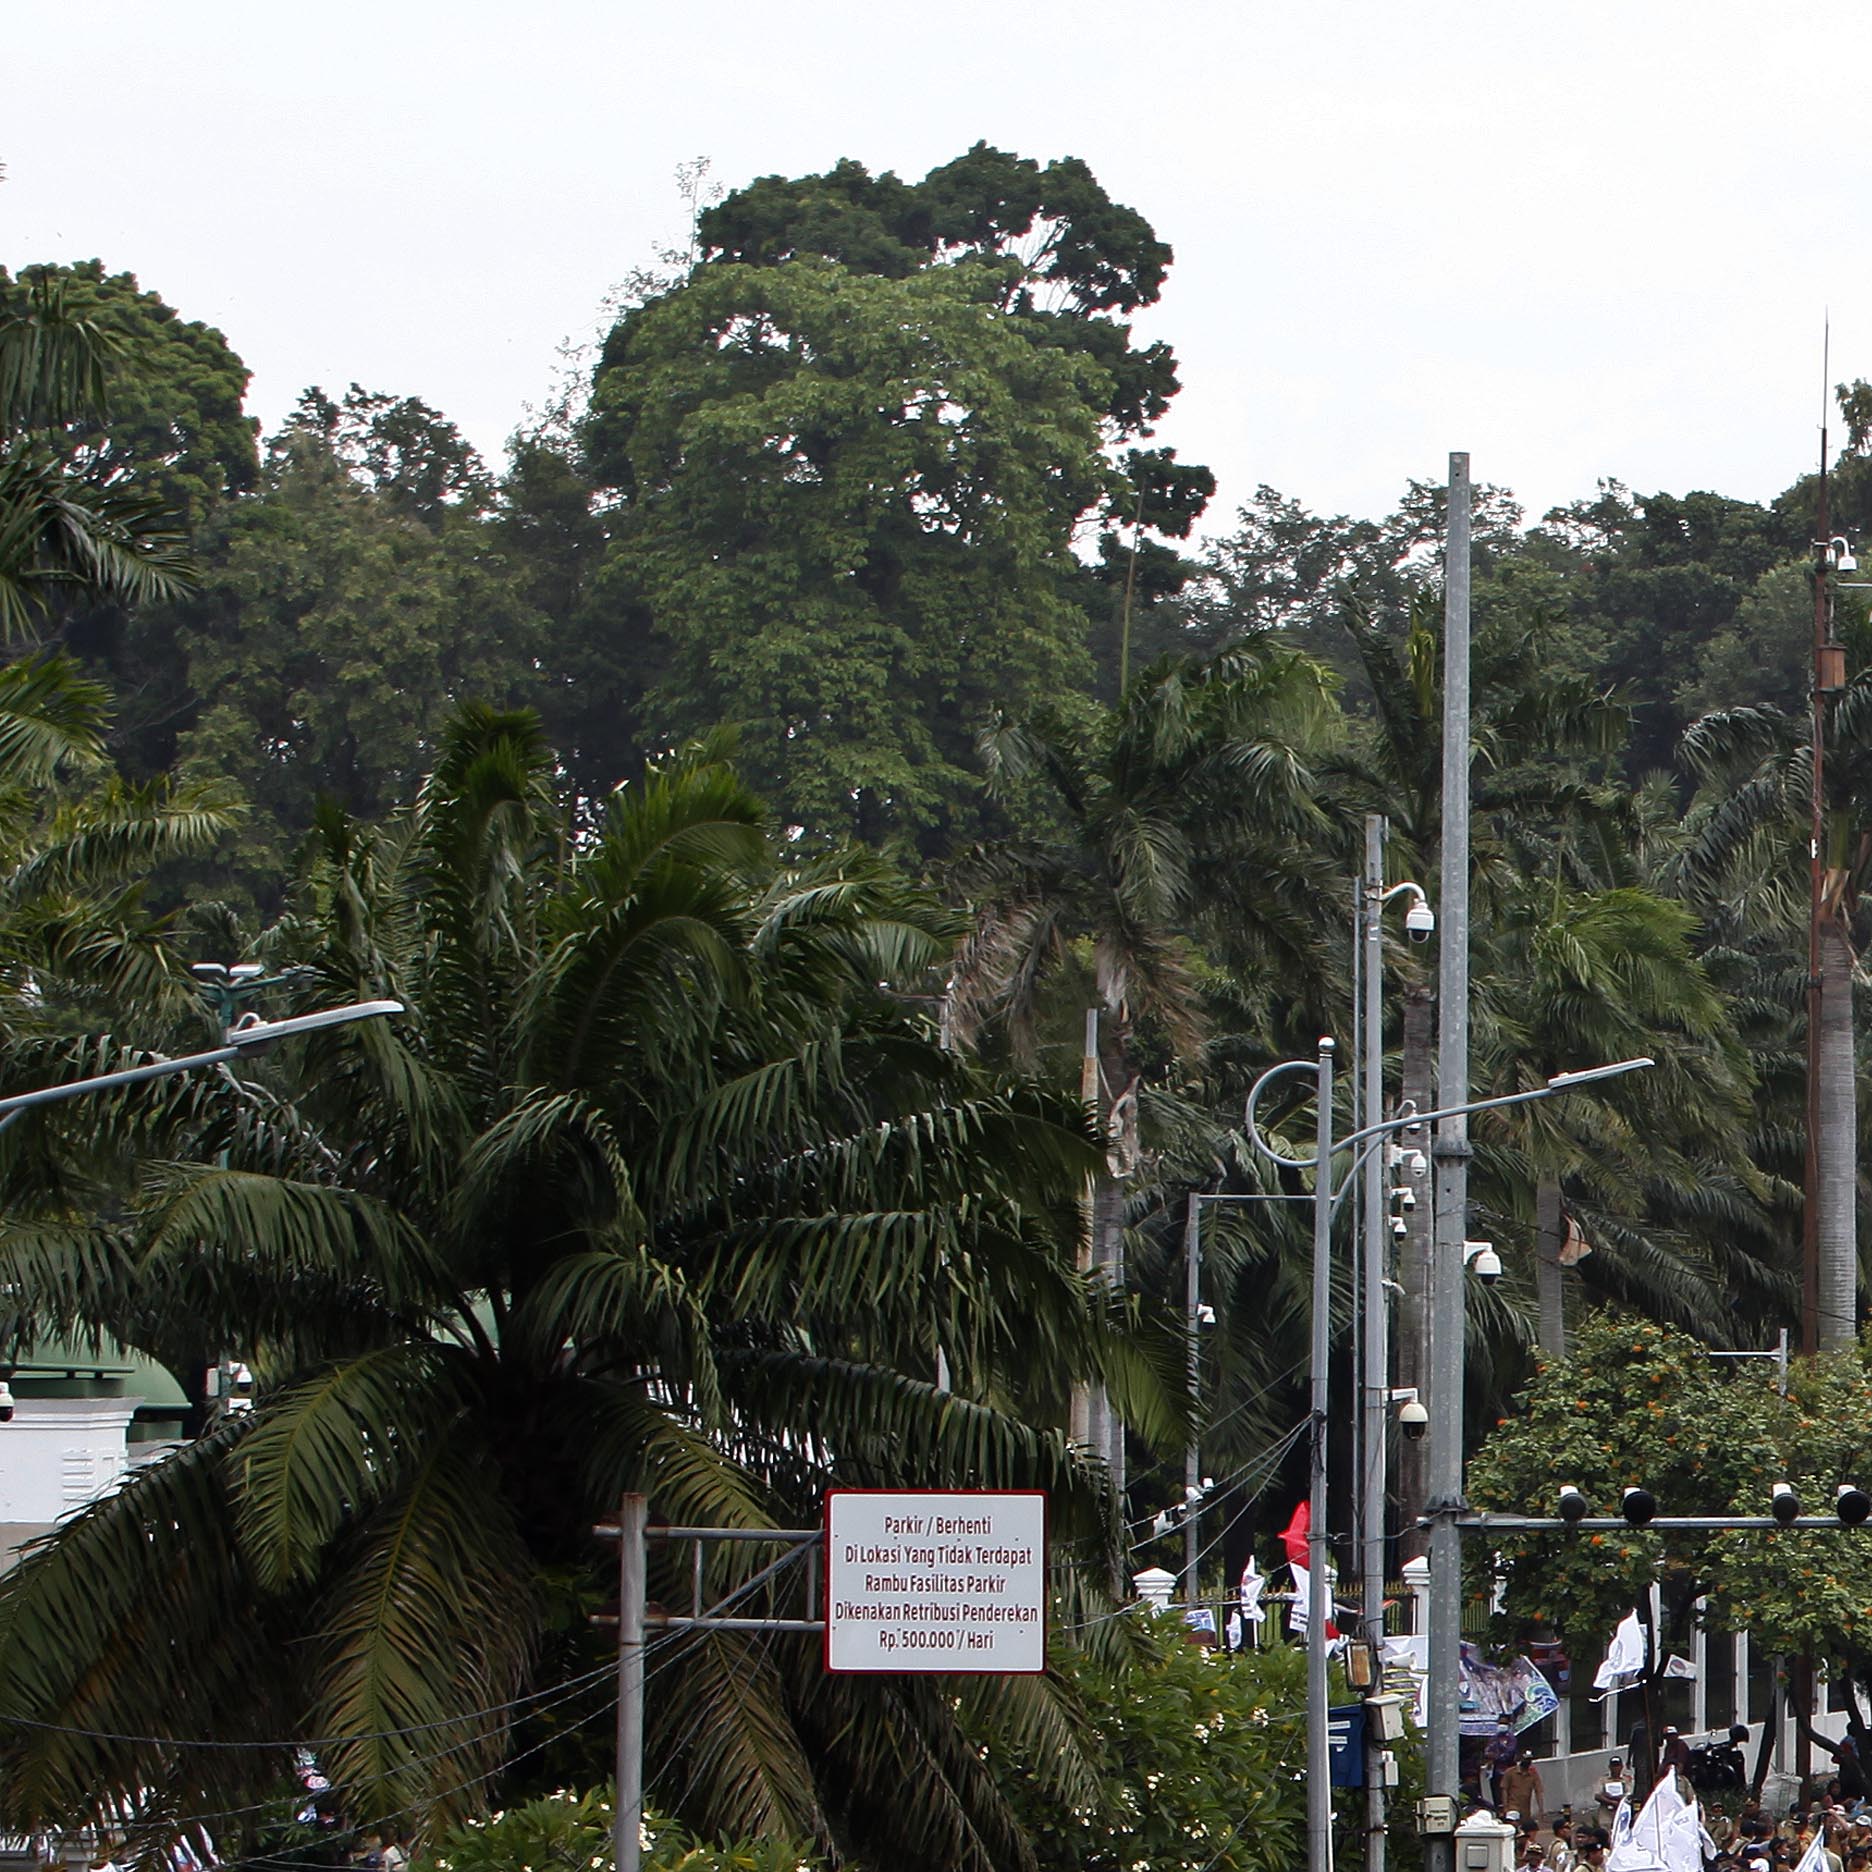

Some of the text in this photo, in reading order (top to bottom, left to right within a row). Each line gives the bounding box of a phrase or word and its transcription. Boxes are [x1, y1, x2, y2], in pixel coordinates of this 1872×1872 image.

[885, 1515, 992, 1537] Parkir / Berhenti
[845, 1545, 1033, 1569] Di Lokasi Yang Tidak Terdapat
[865, 1574, 1006, 1593] Rambu Fasilitas Parkir
[835, 1601, 1038, 1622] Dikenakan Retribusi Penderekan
[879, 1629, 994, 1652] Rp. 500.000 / Hari
